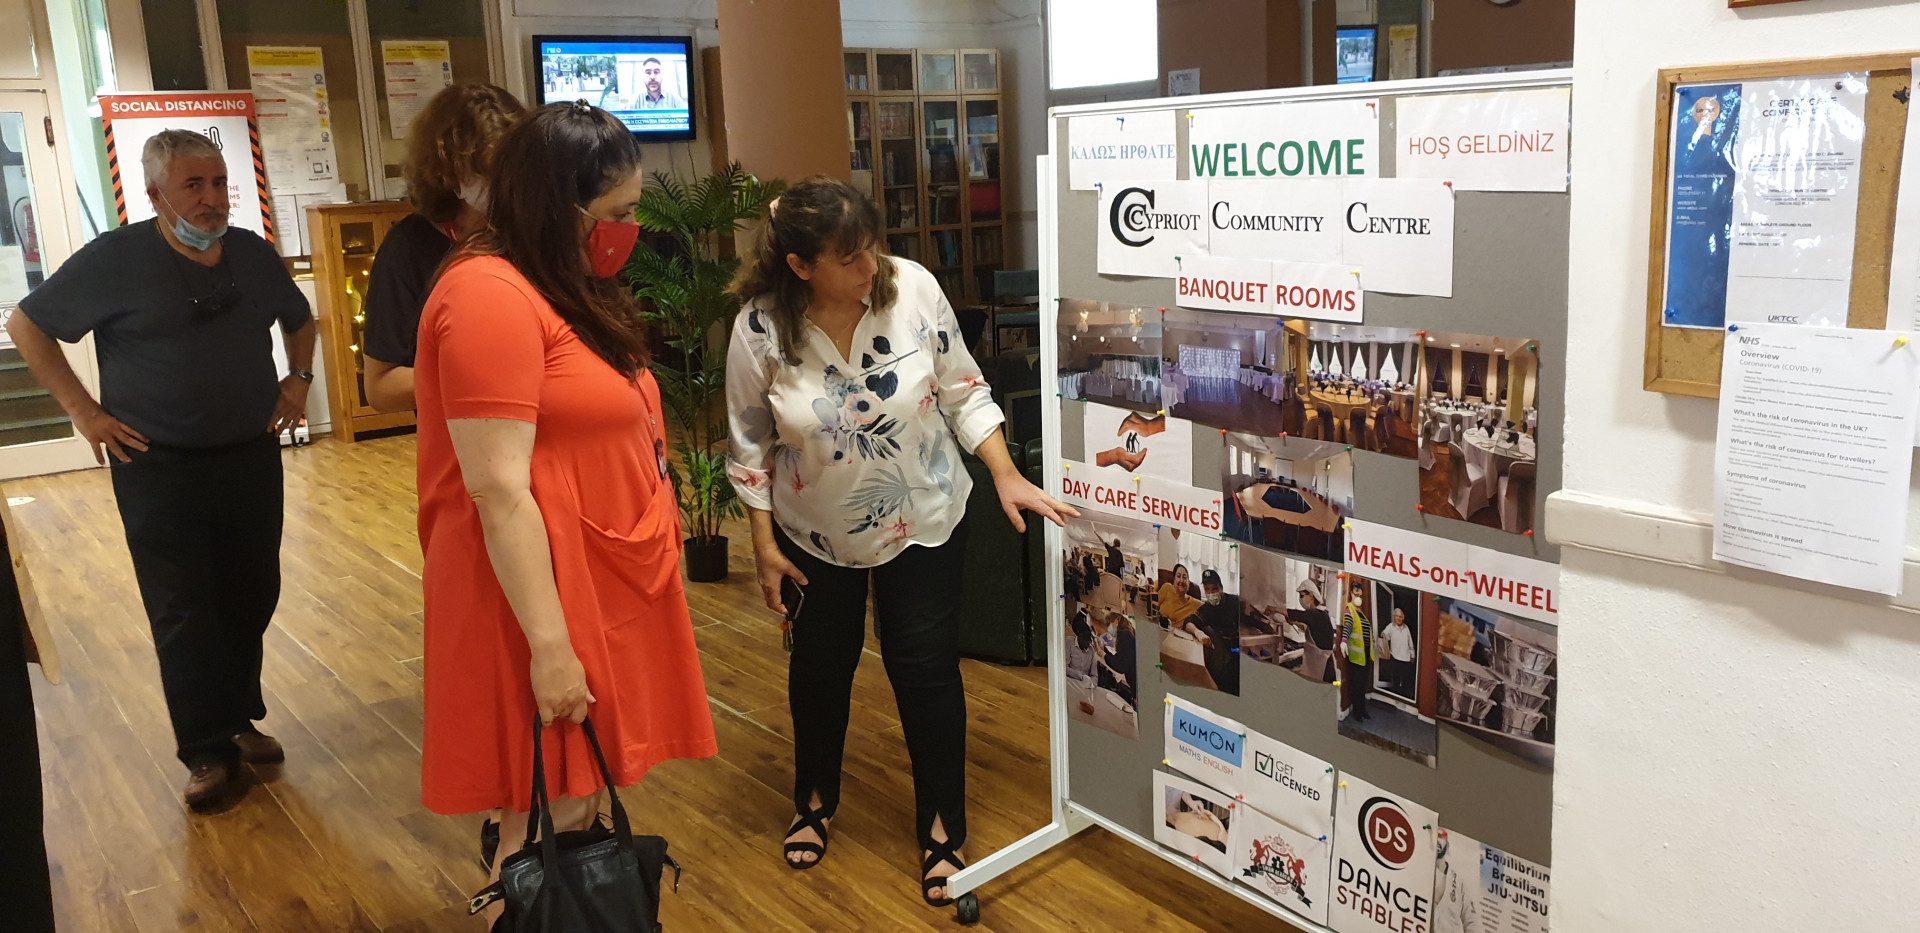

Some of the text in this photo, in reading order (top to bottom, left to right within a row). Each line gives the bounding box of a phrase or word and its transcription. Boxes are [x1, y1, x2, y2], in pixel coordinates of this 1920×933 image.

[111, 100, 247, 113] SOCIAL DISTANCING
[1192, 139, 1365, 177] WELCOME
[1409, 130, 1554, 160] HOŞ GELDİNİZ
[1179, 276, 1356, 312] BANQUET ROOMS
[1767, 314, 1799, 323] UKTCC
[1739, 335, 1760, 346] NHS
[1741, 349, 1780, 361] Overview
[1739, 359, 1780, 370] Coronavirus
[1733, 408, 1755, 417] What's
[1790, 417, 1829, 427] coronavirus
[1730, 438, 1752, 446] What's
[1787, 447, 1825, 457] coronavirus
[1727, 470, 1759, 481] Symptoms
[1769, 479, 1806, 489] coronavirus
[1062, 477, 1220, 531] DAY CARE SERVICES
[1179, 718, 1235, 754] KUMON
[1179, 744, 1234, 776] MATHS ENGLISH
[1275, 760, 1295, 776] GET
[1274, 771, 1321, 801] LICENSED
[1374, 816, 1407, 853] DS
[1338, 857, 1428, 924] DANCE
[1492, 867, 1545, 899] Brazilian
[1487, 882, 1548, 917] JIU-JITSU
